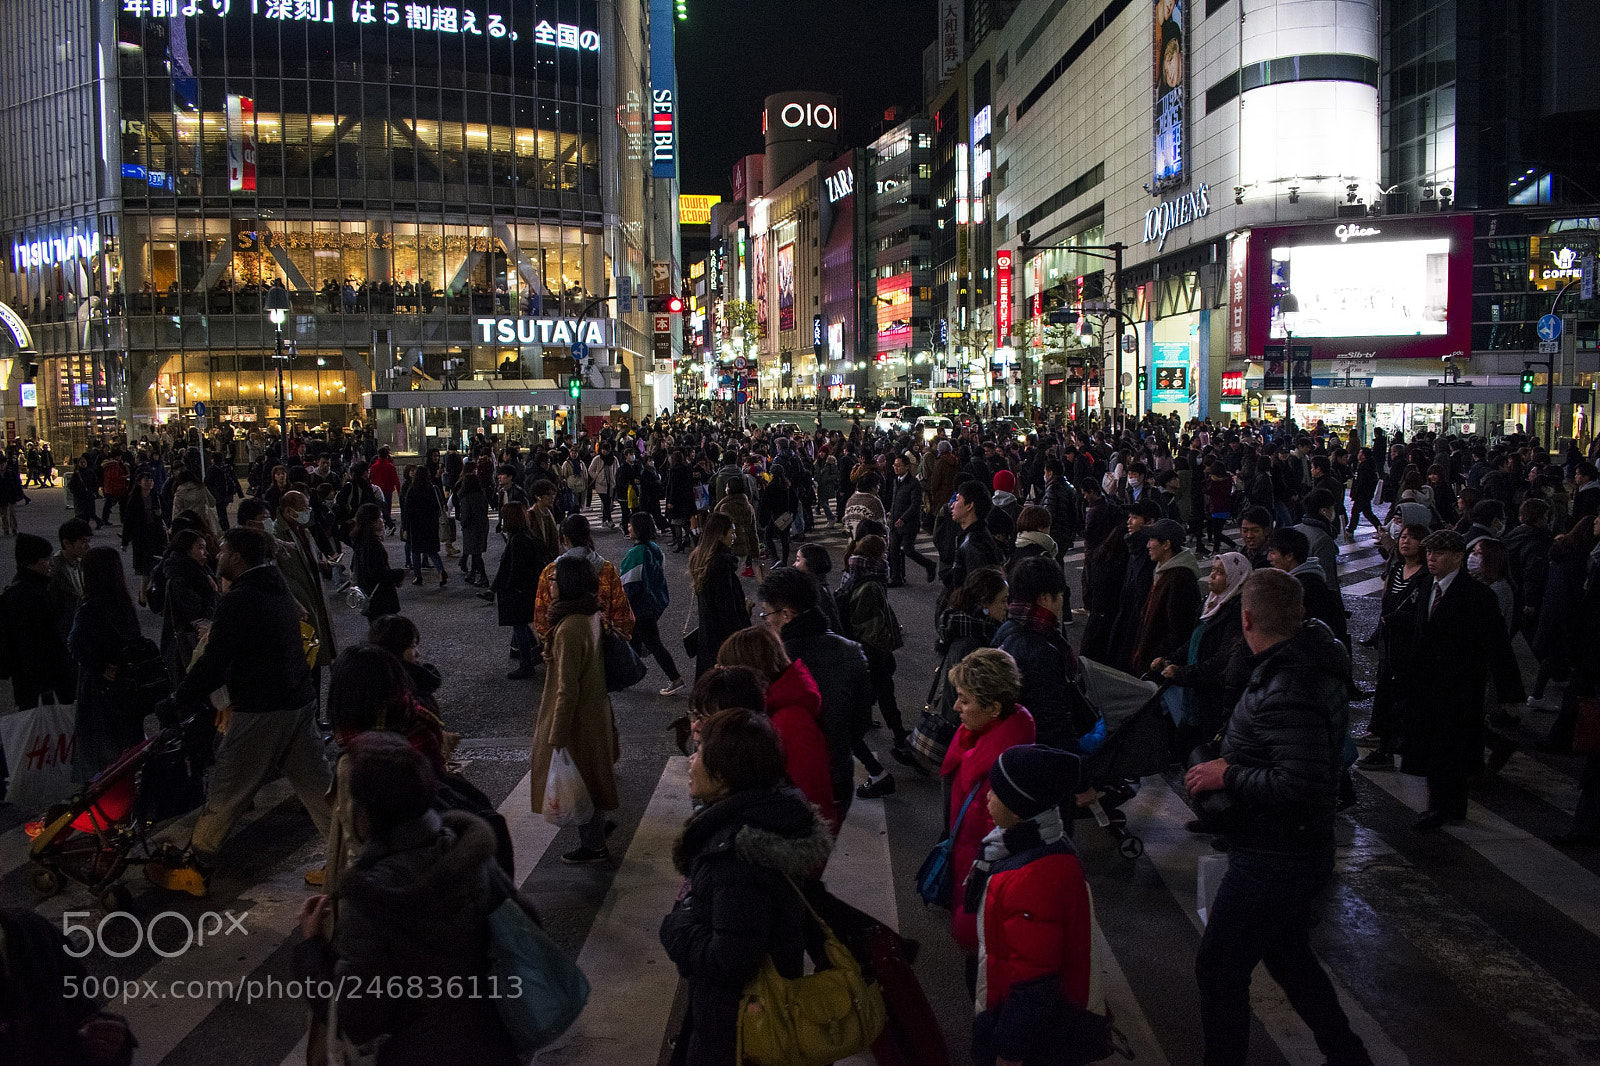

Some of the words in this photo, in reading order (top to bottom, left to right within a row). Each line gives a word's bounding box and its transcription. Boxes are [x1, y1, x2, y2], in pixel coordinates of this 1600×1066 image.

[534, 19, 600, 51] 全国の
[653, 89, 673, 161] SEIBU
[825, 167, 853, 204] ZARA
[679, 197, 709, 209] TOWER
[15, 230, 100, 267] TSUTAYA
[1335, 224, 1381, 243] Glico
[710, 249, 718, 291] KARAOKE
[1542, 269, 1583, 279] COFFE
[477, 318, 603, 345] TSUTAYA
